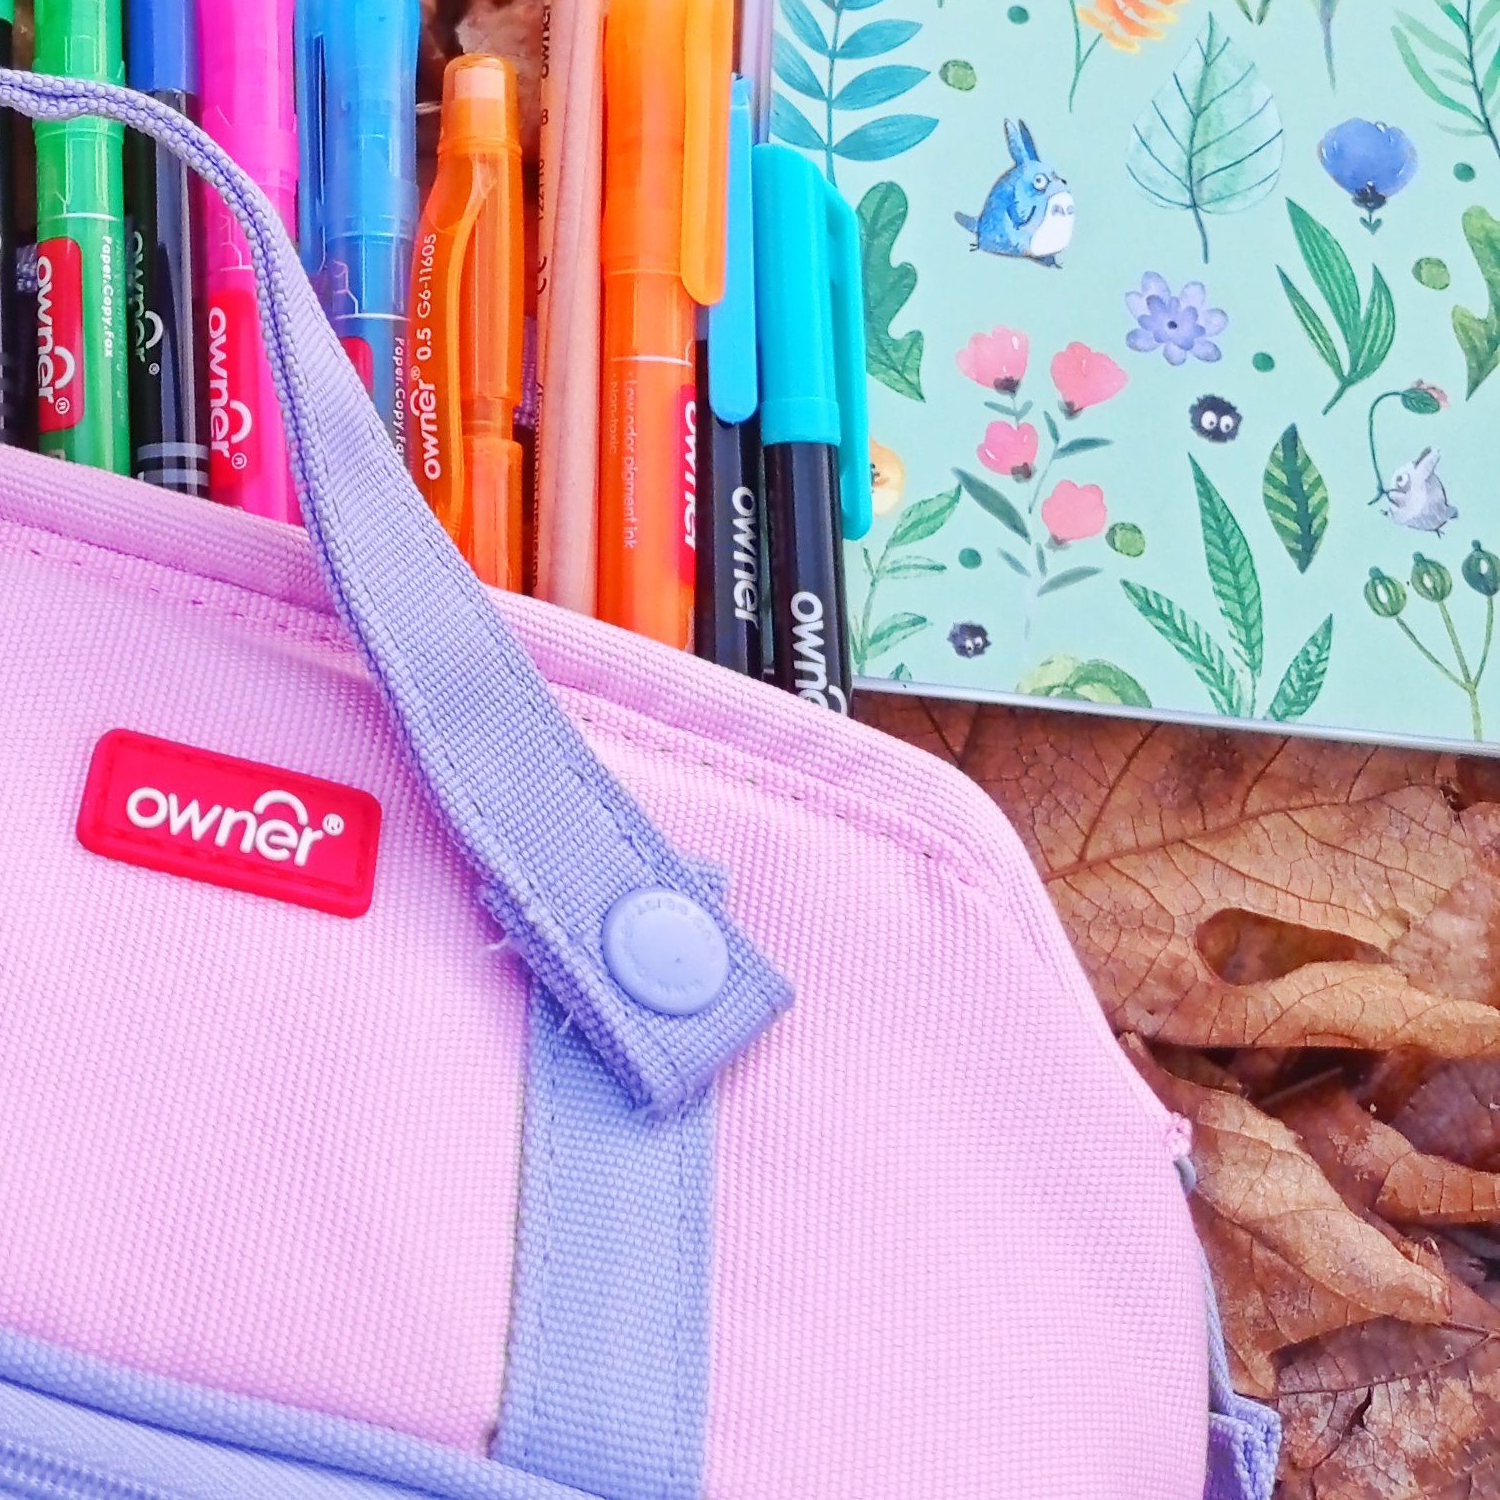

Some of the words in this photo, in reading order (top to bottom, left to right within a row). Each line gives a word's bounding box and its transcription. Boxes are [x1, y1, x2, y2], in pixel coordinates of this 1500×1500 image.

[417, 233, 437, 319] G6-11605
[416, 327, 432, 361] 0.5
[732, 486, 760, 629] owner
